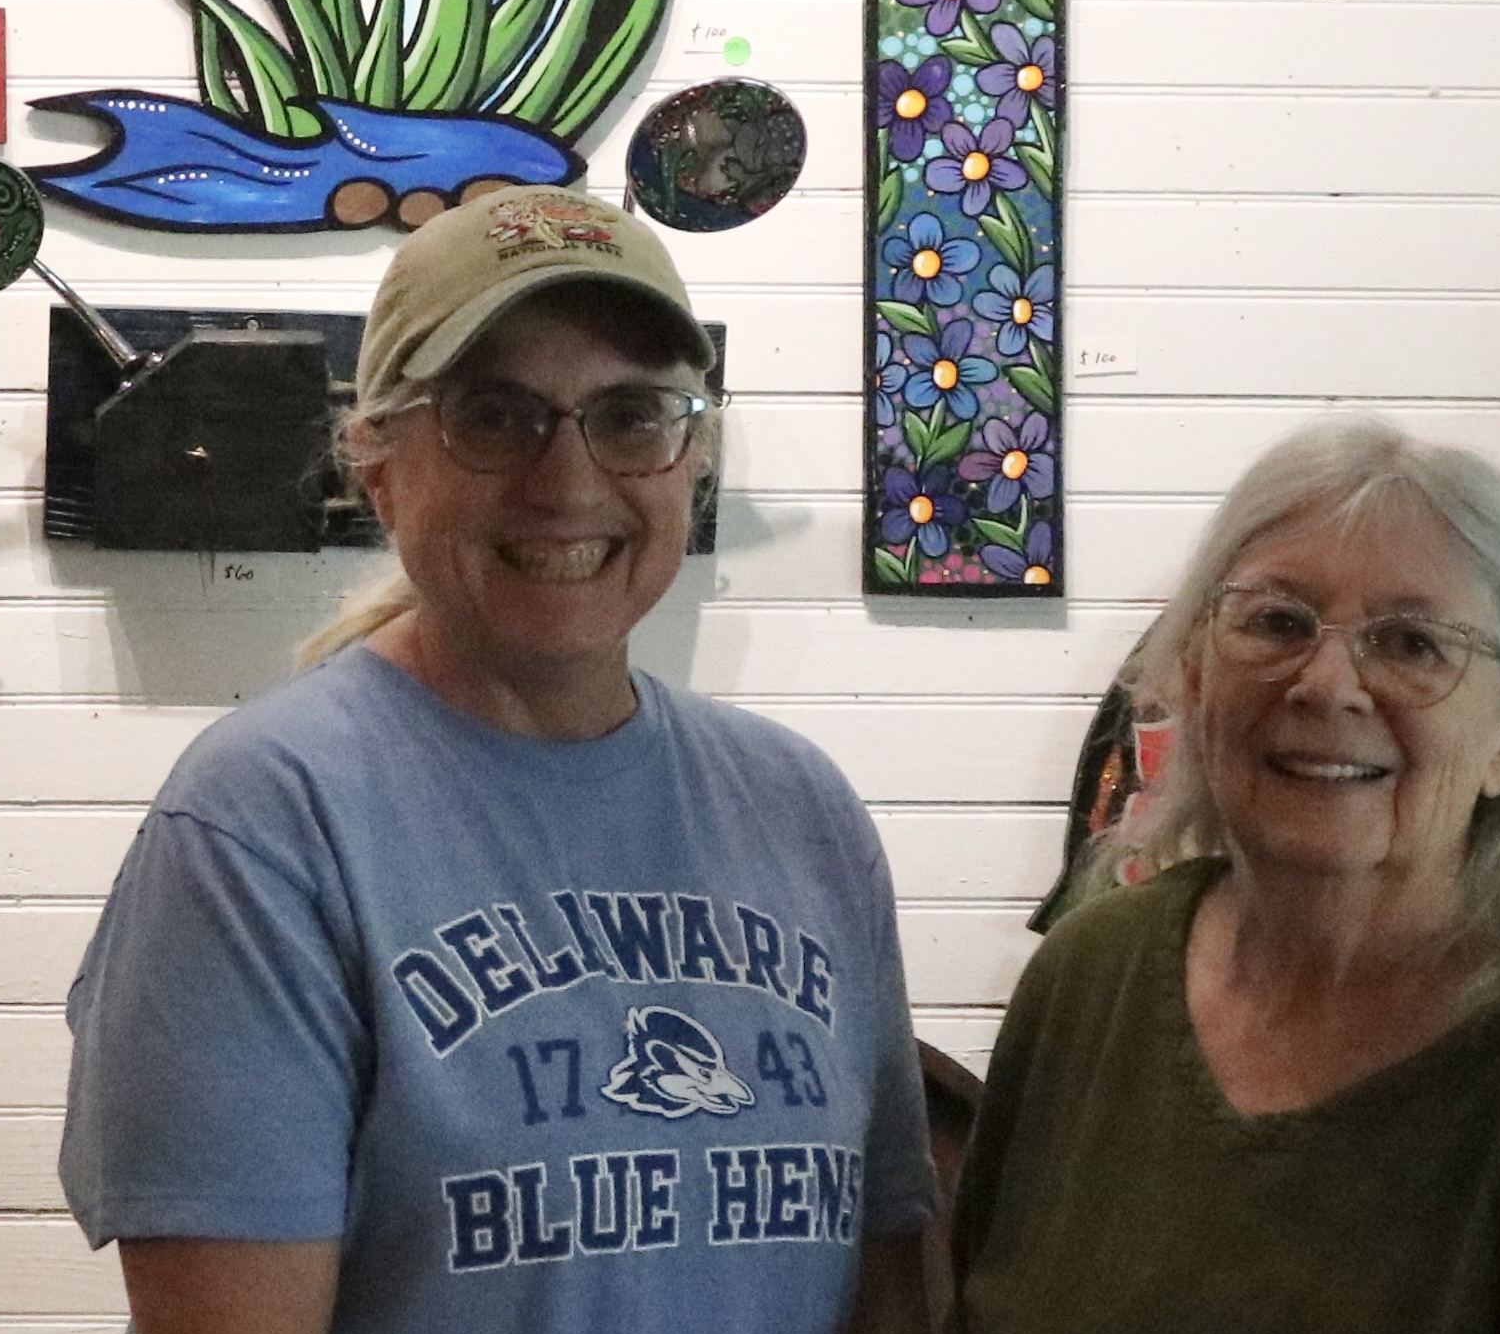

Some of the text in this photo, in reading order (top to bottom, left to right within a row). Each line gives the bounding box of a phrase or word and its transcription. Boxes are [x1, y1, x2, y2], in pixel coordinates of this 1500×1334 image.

[692, 21, 728, 44] $100
[1079, 349, 1117, 367] $100
[506, 1030, 829, 1126] 17 43
[440, 1142, 864, 1274] BLUE HENS
